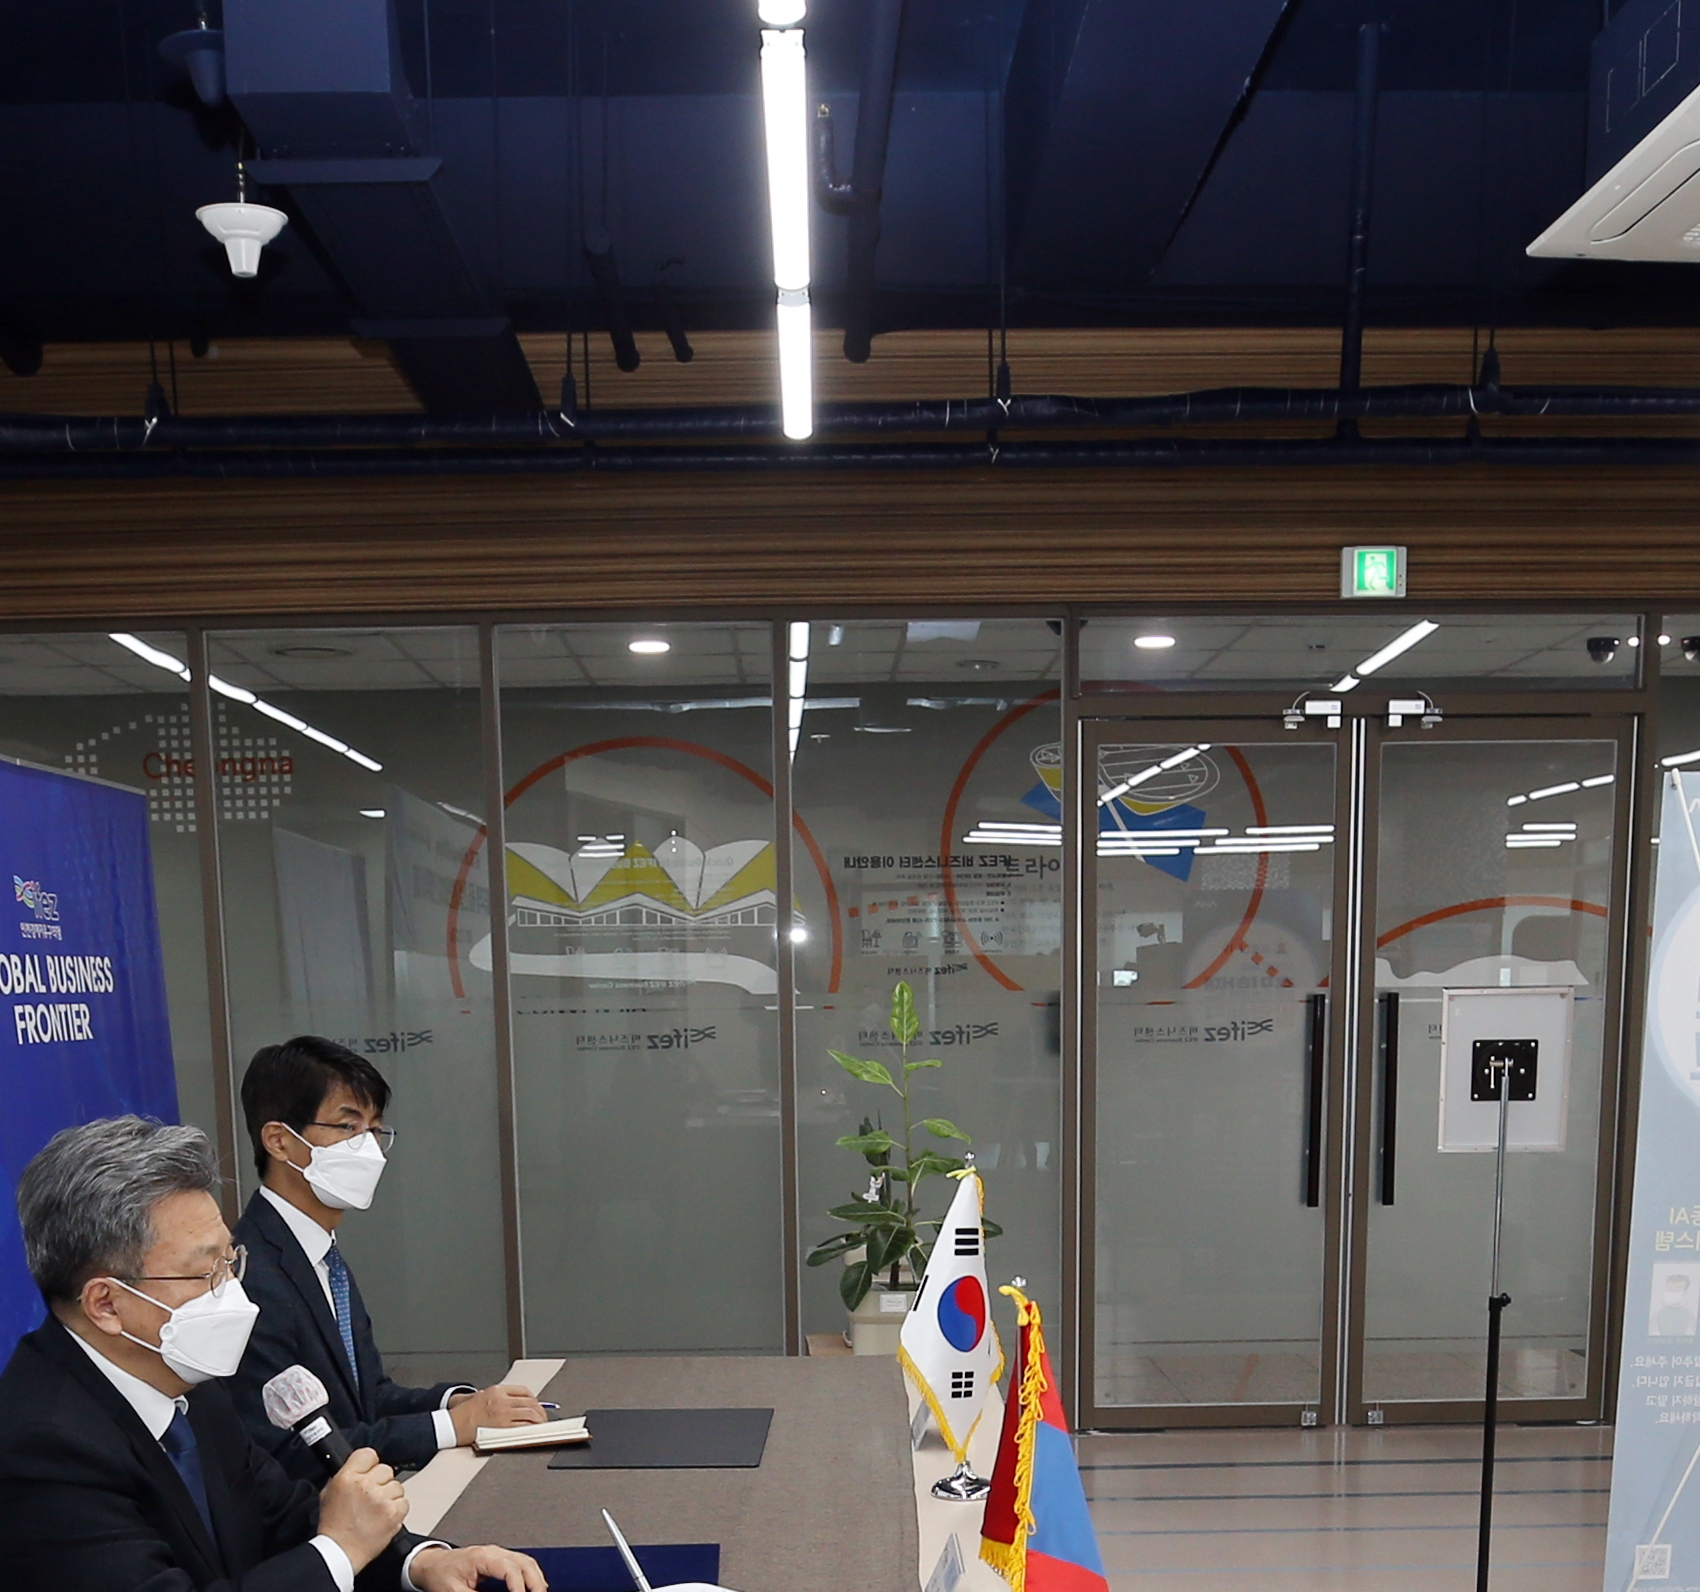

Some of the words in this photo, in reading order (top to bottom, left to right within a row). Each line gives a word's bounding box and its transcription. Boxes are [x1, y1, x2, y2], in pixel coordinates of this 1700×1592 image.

[143, 754, 293, 783] Chengna
[48, 955, 114, 994] BUSINESS
[13, 1003, 94, 1045] FRONTIER
